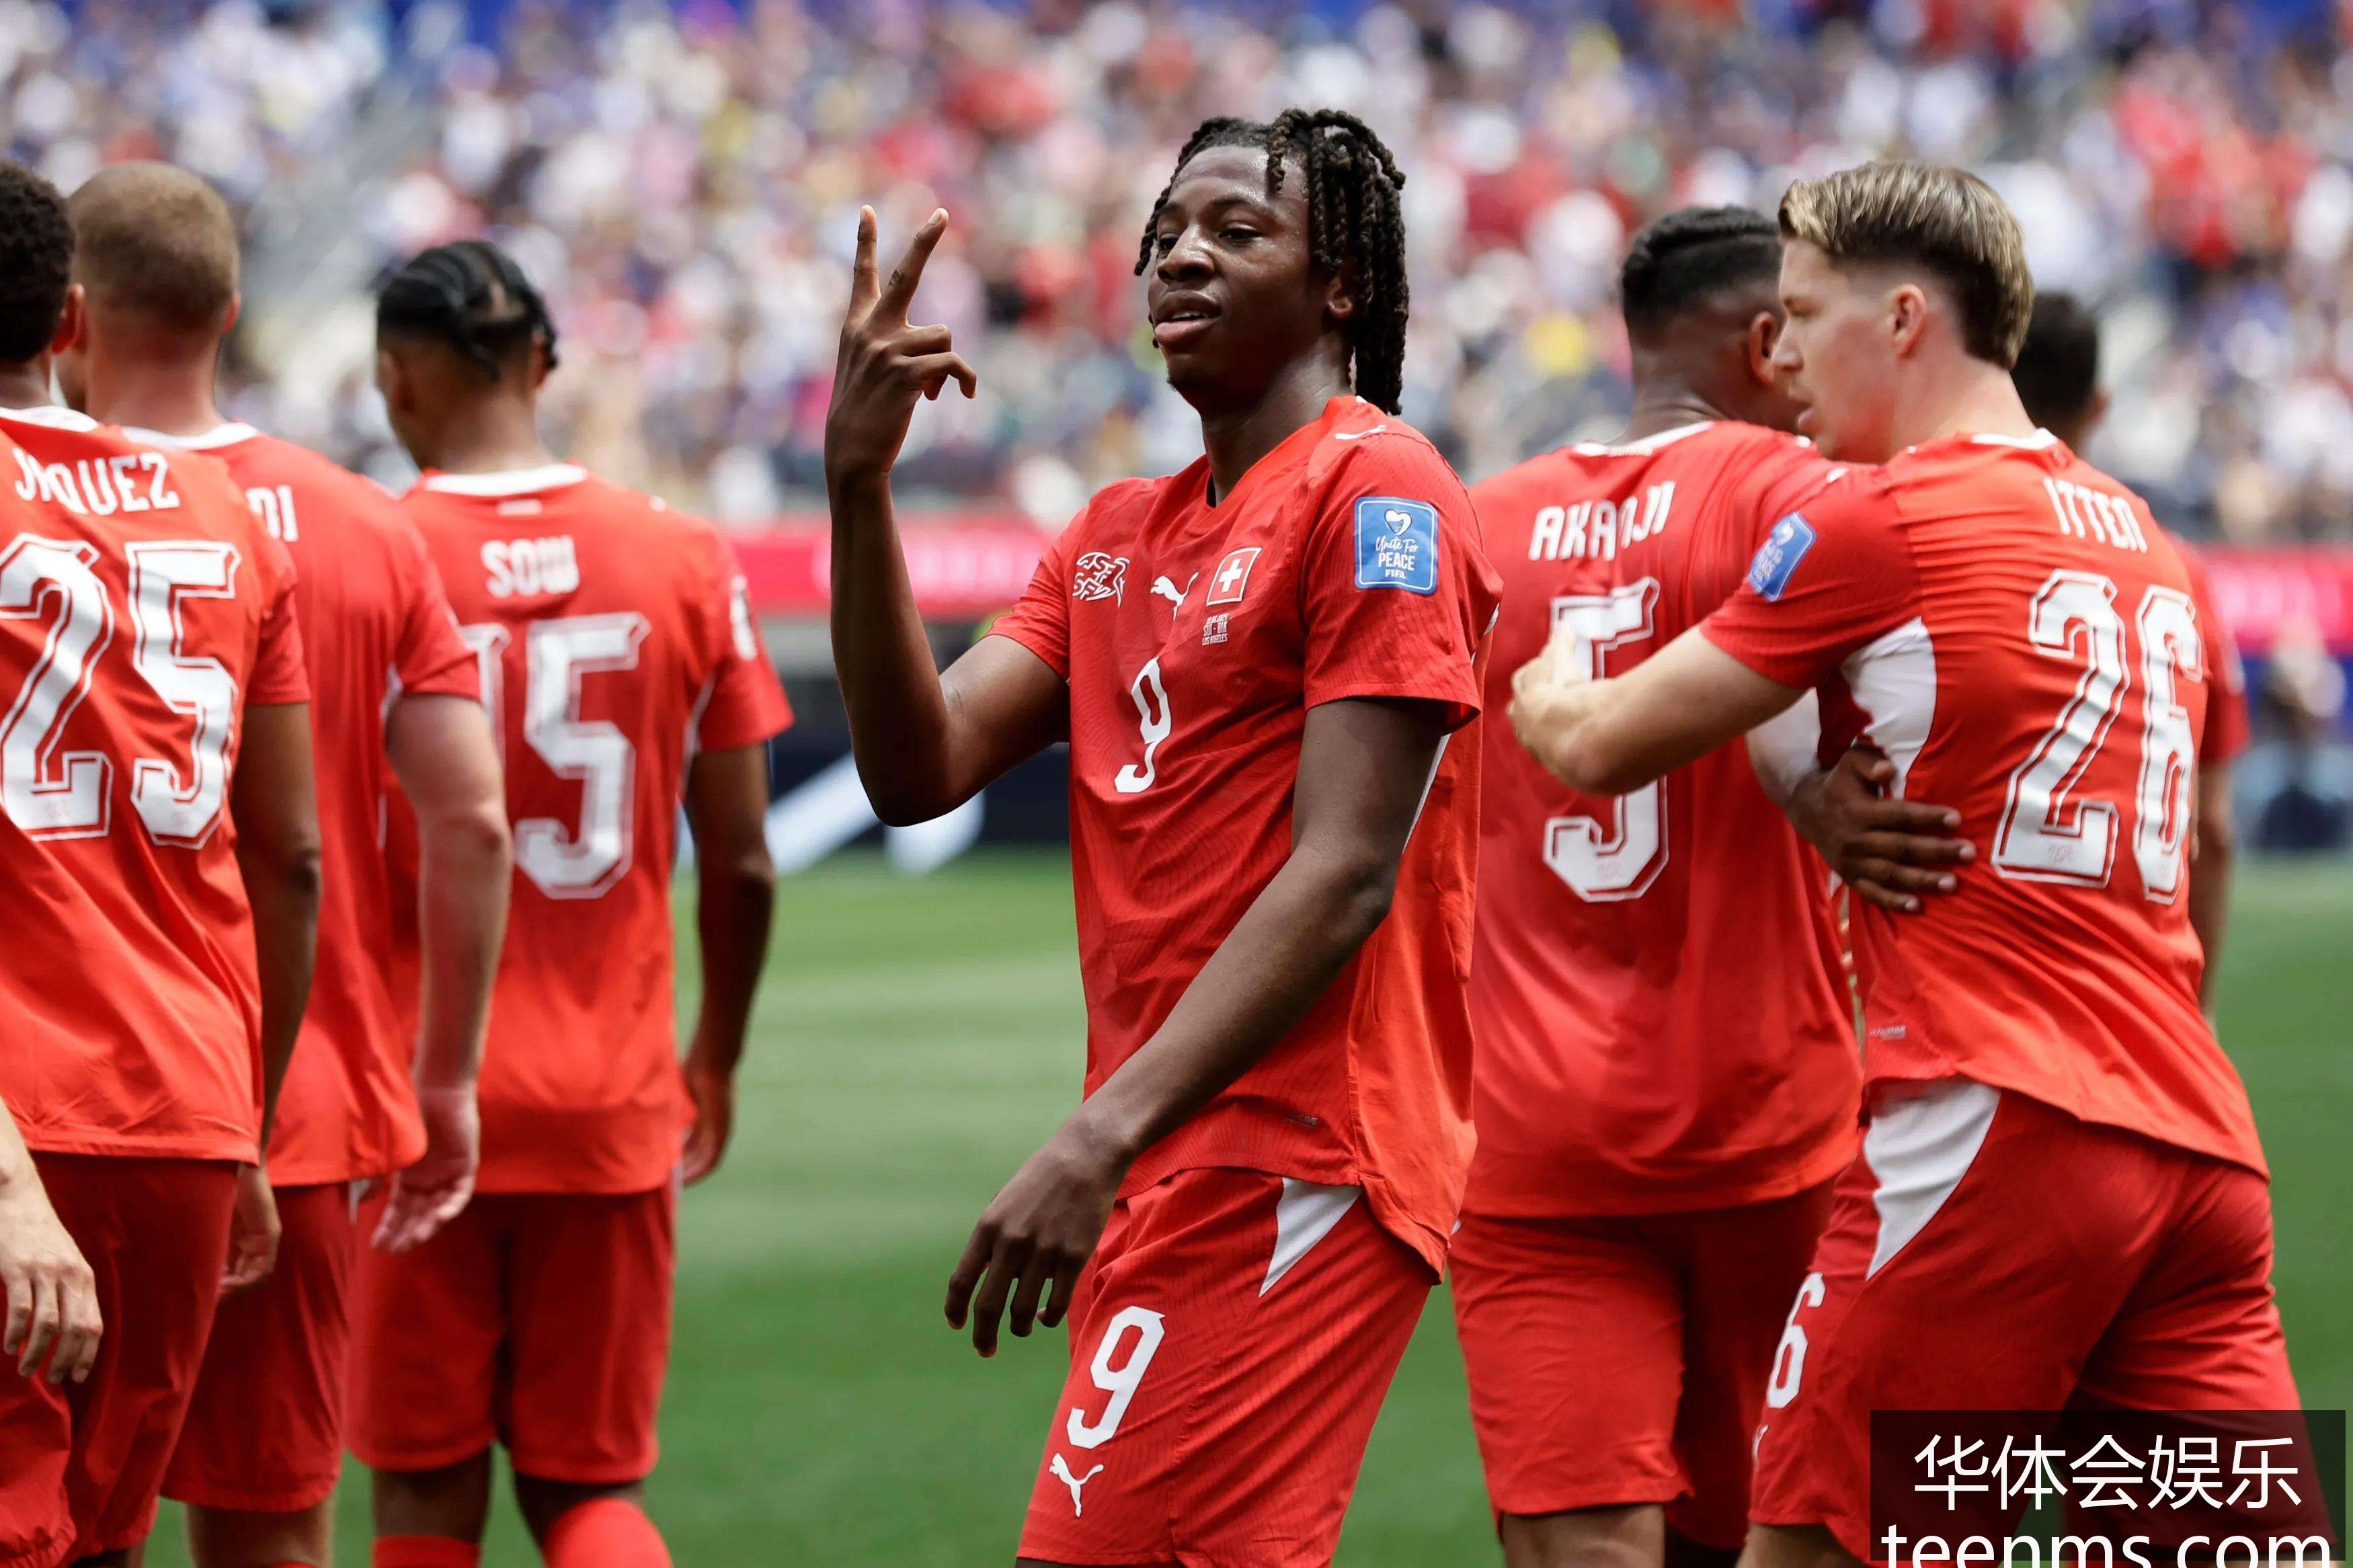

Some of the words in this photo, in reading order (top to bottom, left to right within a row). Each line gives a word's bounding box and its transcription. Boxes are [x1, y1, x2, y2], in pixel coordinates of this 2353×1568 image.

[481, 535, 581, 598] SOW
[1375, 535, 1403, 552] Unite
[1403, 539, 1419, 553] For
[1378, 552, 1415, 571] PEACE
[1527, 481, 1675, 561] AKANJI
[2042, 477, 2148, 553] ITTEN
[1385, 569, 1406, 579] FIFA
[0, 533, 241, 849] 25
[1114, 657, 1171, 793] 9
[1543, 576, 1670, 902] 5
[1991, 569, 2202, 905] 26
[1067, 1305, 1166, 1449] 9
[1766, 1271, 1826, 1409] 6
